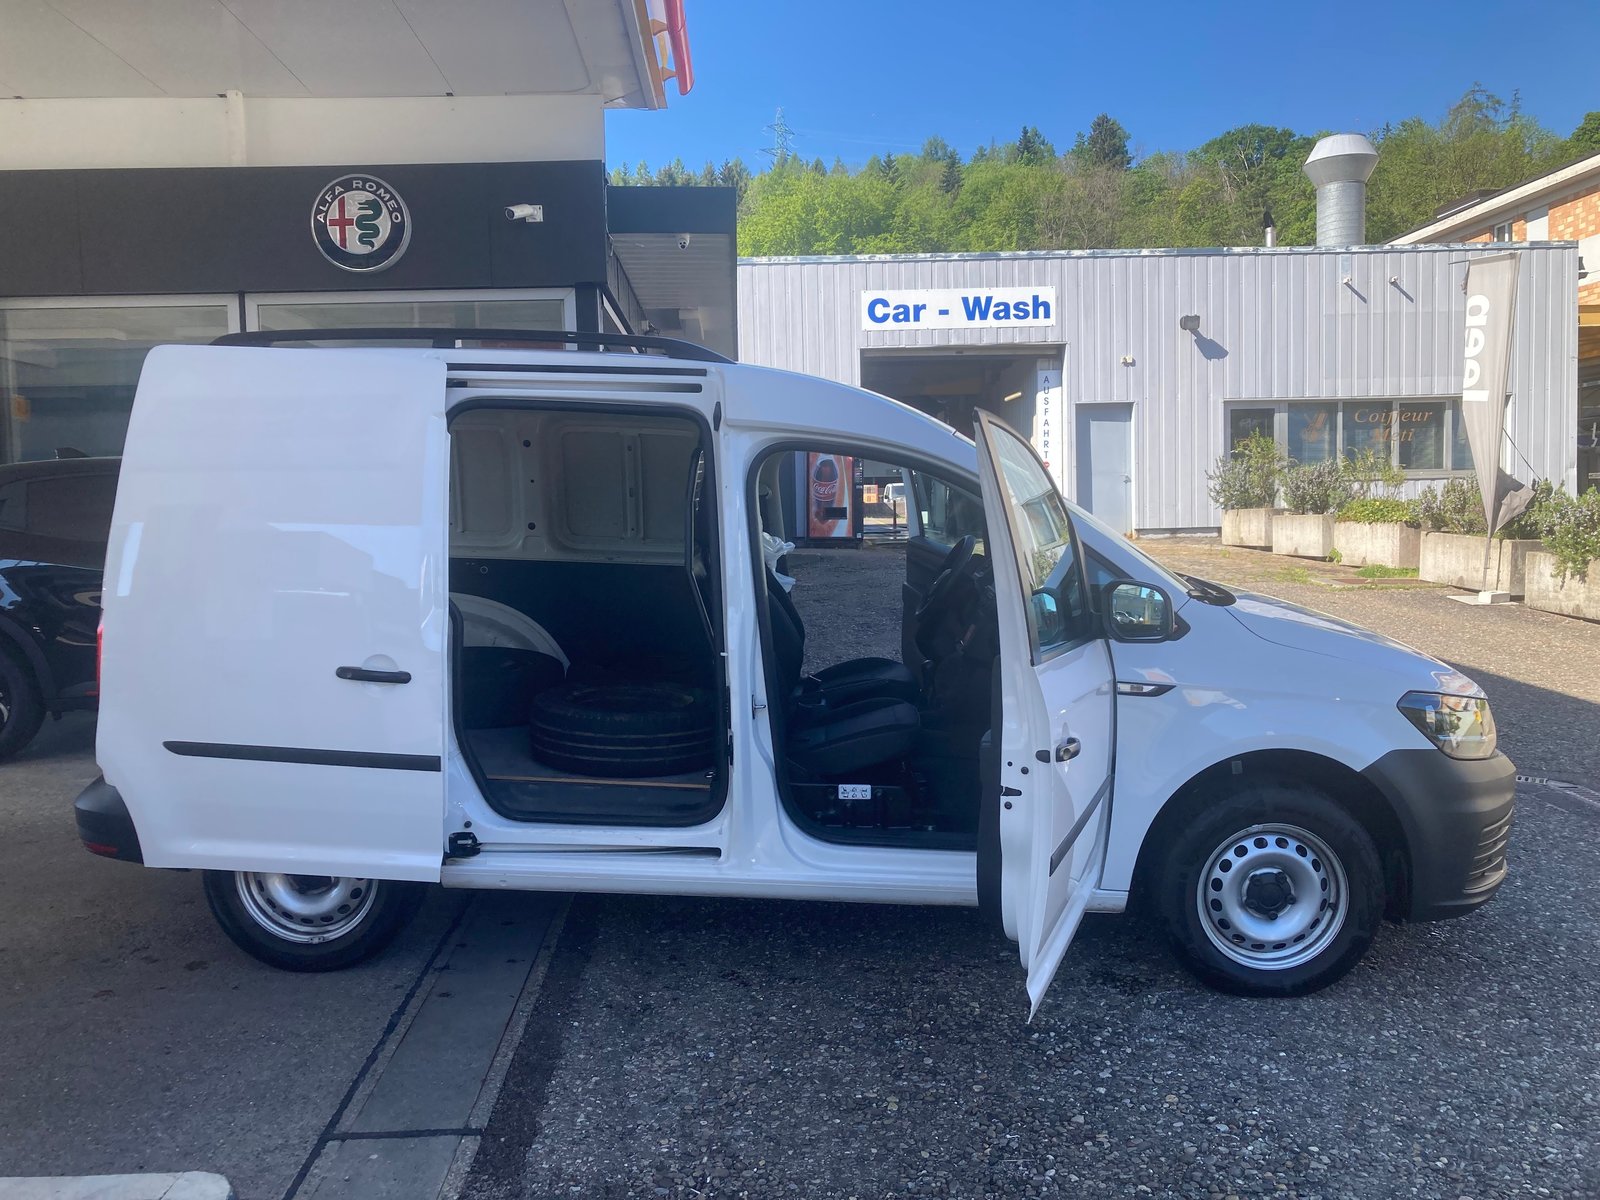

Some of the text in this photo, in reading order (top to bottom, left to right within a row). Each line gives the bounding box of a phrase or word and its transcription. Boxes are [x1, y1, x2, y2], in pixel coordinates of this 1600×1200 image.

[316, 180, 401, 223] ALFA ROMEO
[867, 297, 927, 324] Car
[961, 295, 1051, 321] Wash
[1354, 408, 1433, 426] Coiffeur
